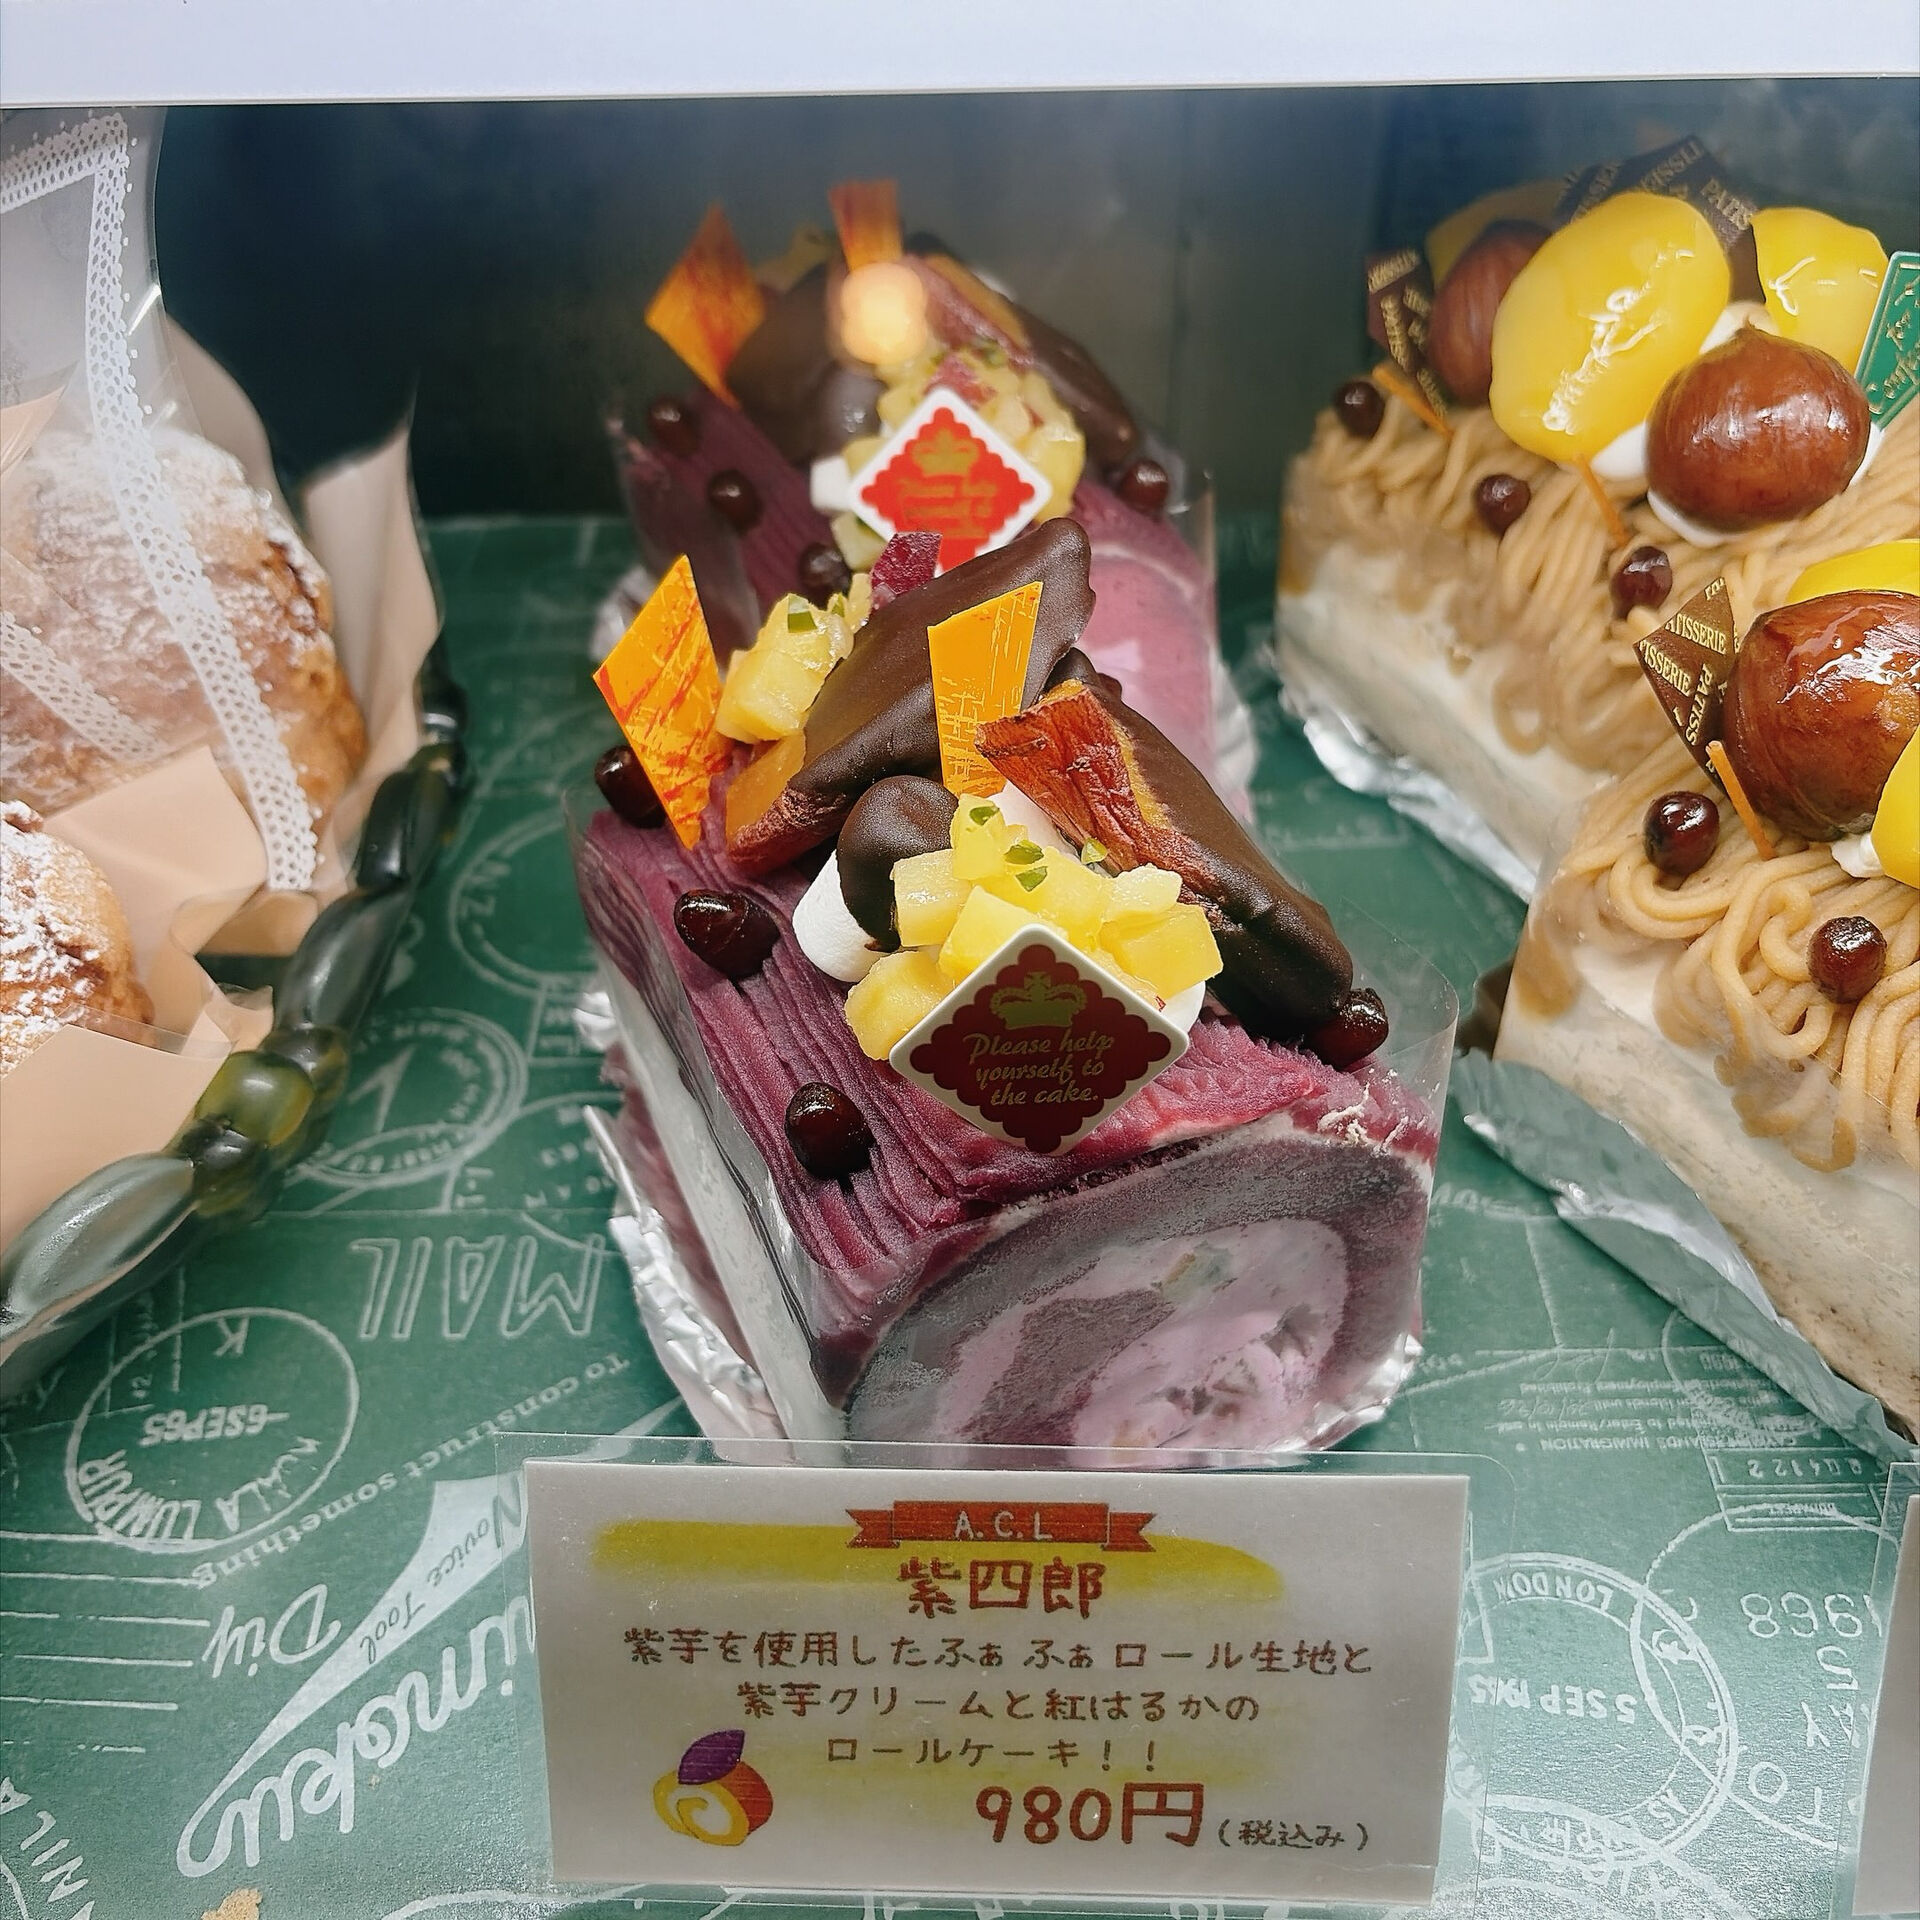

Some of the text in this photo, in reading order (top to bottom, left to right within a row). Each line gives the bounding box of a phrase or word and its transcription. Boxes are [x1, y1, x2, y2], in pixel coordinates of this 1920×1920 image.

[963, 1027, 1115, 1066] Please help
[975, 1055, 1105, 1090] yourself to
[990, 1078, 1100, 1106] the cake.
[351, 1231, 606, 1341] MAIL
[190, 1352, 631, 1591] To construct something
[954, 1509, 1053, 1541] A.C.L
[359, 1473, 522, 1666] Novice Tool
[896, 1555, 1107, 1619] 紫四郎
[202, 1584, 342, 1679] Diy
[1816, 1645, 1859, 1690] 5
[736, 1681, 1260, 1721] 紫芋クリームと紅はるかの
[1539, 1683, 1608, 1719] SEP
[1614, 1692, 1638, 1725] 5
[975, 1782, 1204, 1847] 980円
